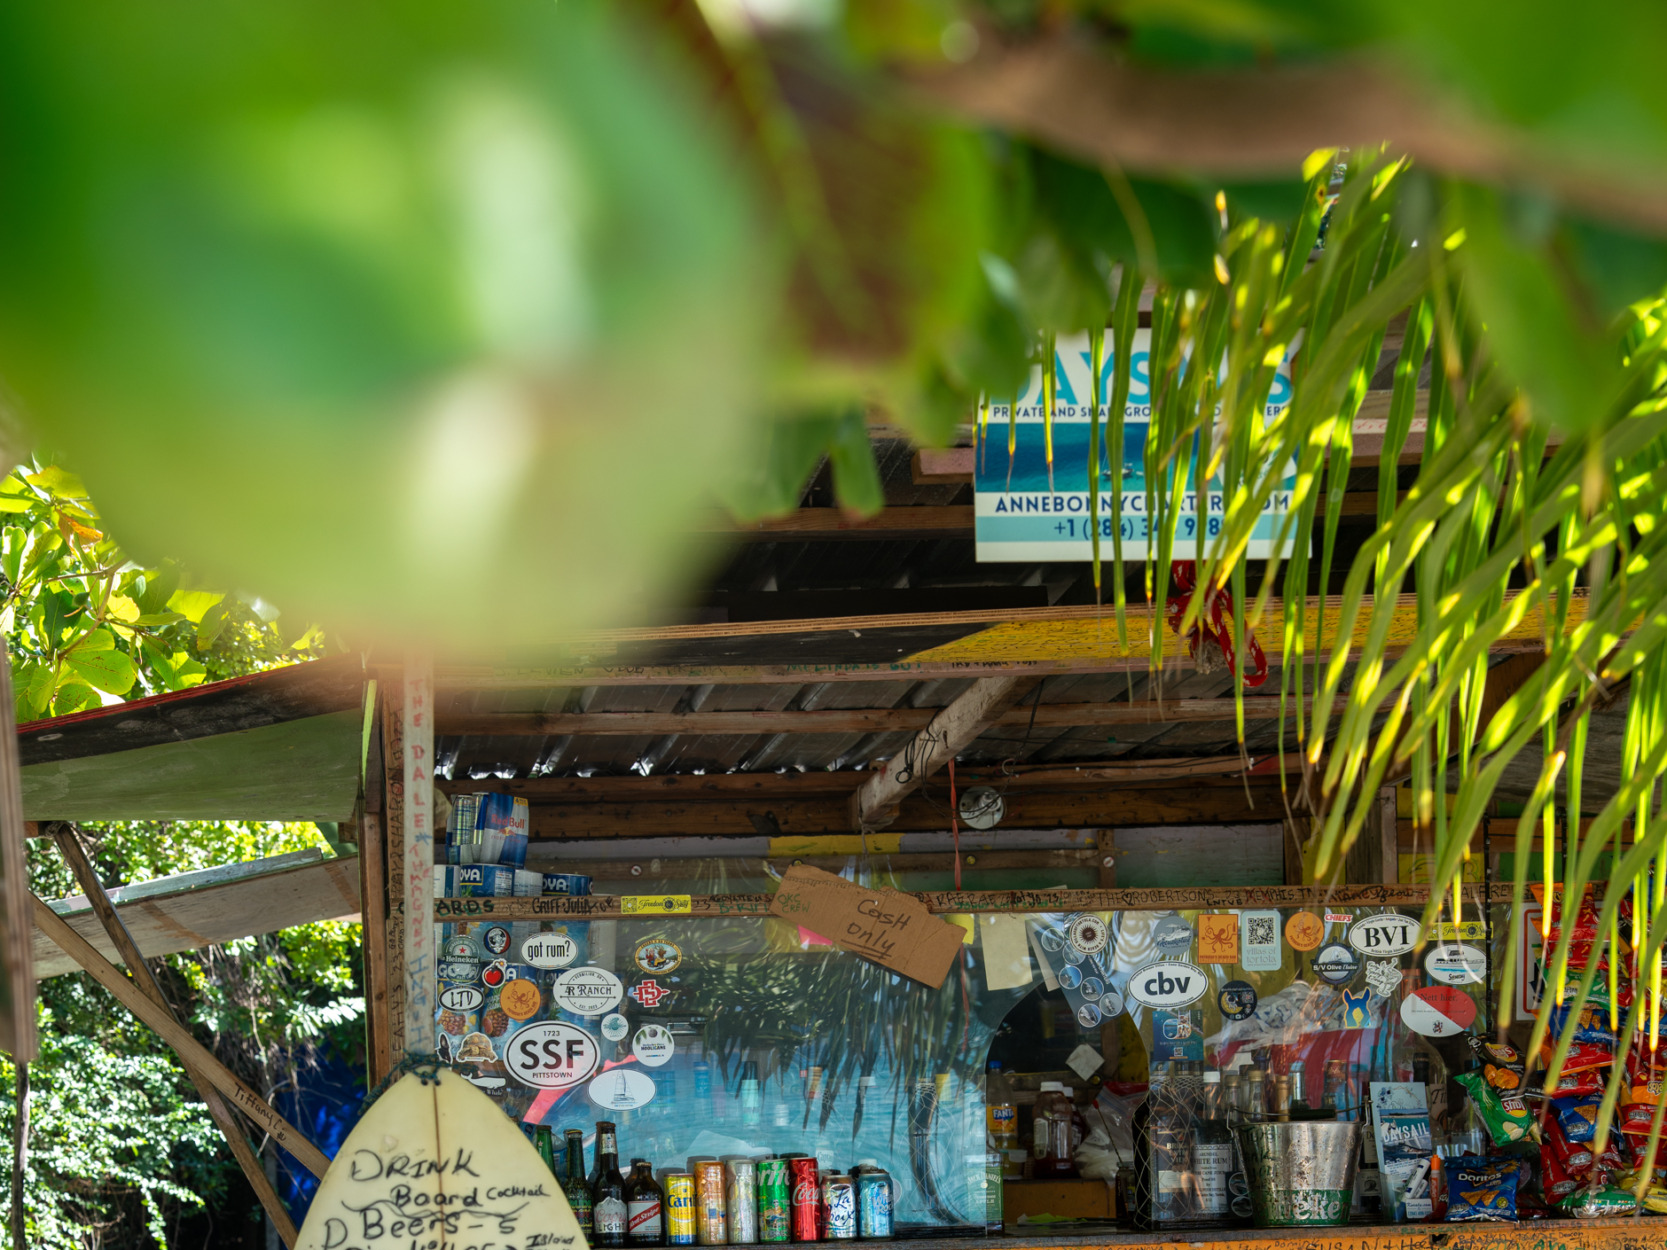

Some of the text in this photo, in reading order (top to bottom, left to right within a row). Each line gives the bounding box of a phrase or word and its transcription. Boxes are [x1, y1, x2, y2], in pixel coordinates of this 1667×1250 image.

[993, 406, 1044, 418] PRVATE
[491, 813, 526, 829] Red Bull
[1324, 914, 1353, 923] CHIEFS
[1363, 925, 1410, 948] BVI
[527, 939, 571, 959] got rum?
[445, 955, 480, 965] Heineken
[1144, 971, 1192, 997] cbv
[449, 990, 475, 1009] LTD
[519, 1038, 585, 1071] SSF
[532, 1071, 573, 1080] PITTSTOWN
[350, 1148, 481, 1182] DRINK
[1458, 1171, 1502, 1187] Doritos
[391, 1183, 484, 1208] Board
[792, 1182, 820, 1207] Coca
[835, 1188, 851, 1210] La
[640, 1206, 660, 1221] Stripe
[358, 1206, 462, 1242] Beers
